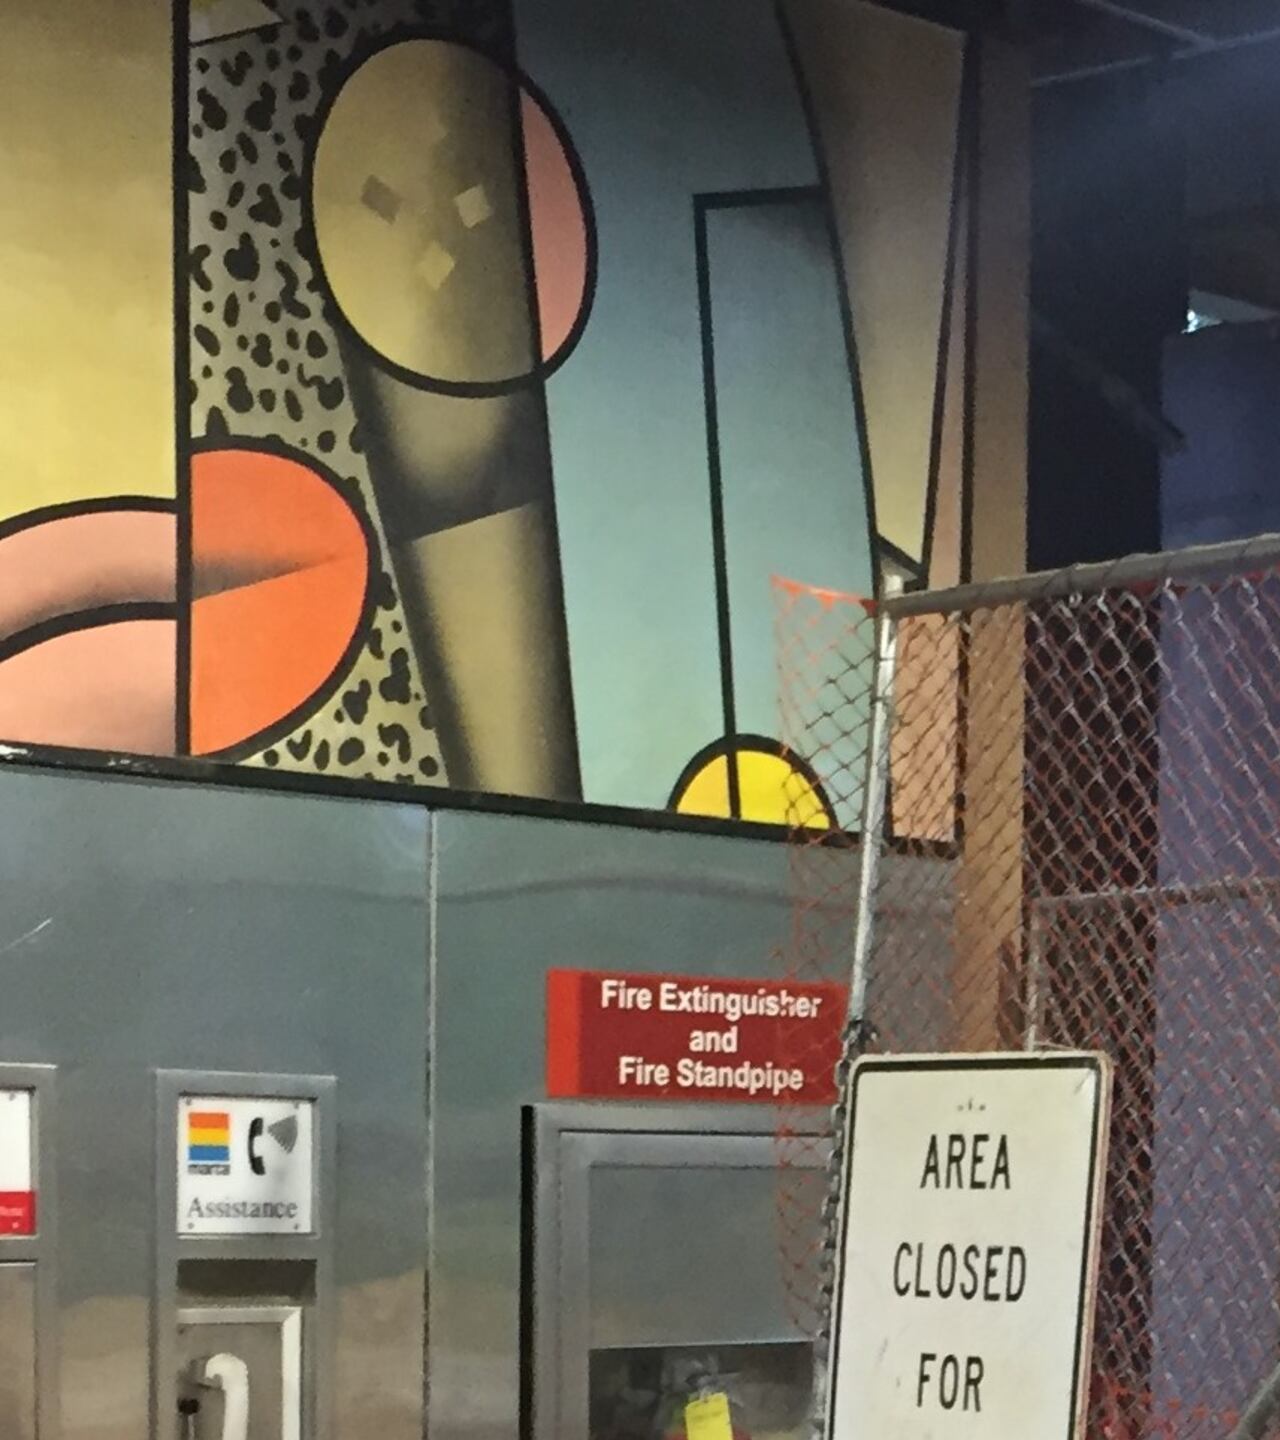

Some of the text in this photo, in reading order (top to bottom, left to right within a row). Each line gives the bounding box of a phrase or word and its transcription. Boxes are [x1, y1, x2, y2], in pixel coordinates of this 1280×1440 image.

[601, 978, 823, 1022] Fire Extinguisher
[689, 1025, 738, 1053] and
[618, 1055, 804, 1096] Fire Standpipe
[920, 1133, 1011, 1191] AREA
[187, 1197, 298, 1219] Assistance
[893, 1241, 1026, 1303] CLOSED
[917, 1352, 985, 1412] FOR
